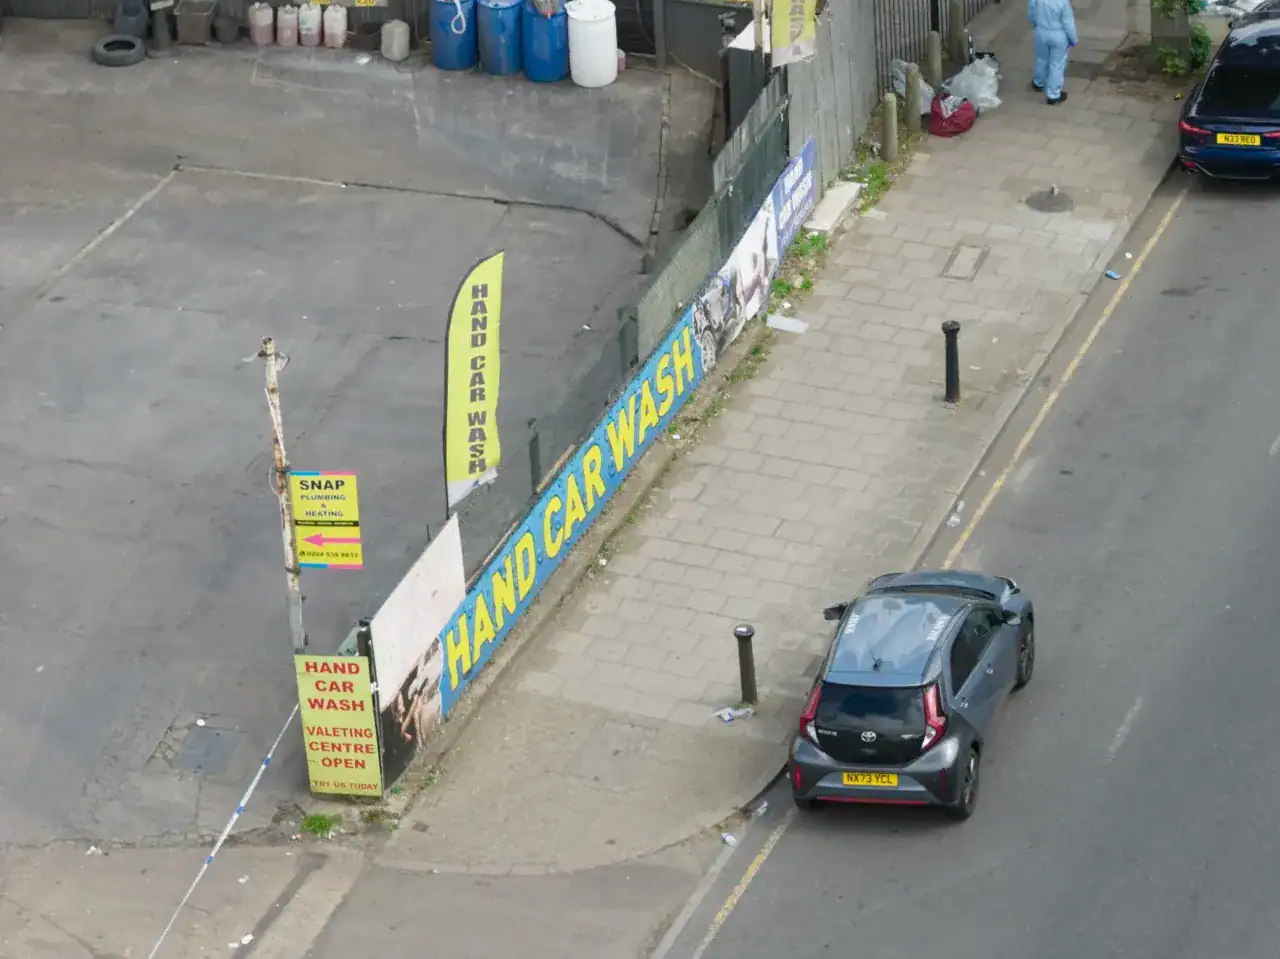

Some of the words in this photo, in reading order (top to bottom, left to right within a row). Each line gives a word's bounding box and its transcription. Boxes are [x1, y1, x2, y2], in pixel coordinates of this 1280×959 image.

[470, 284, 488, 348] HAND
[470, 355, 486, 403] CAR
[467, 410, 488, 474] WASH
[299, 480, 346, 490] SNAP
[445, 531, 536, 691] HAND
[542, 443, 607, 559] CAR
[606, 325, 696, 473] WASH
[304, 660, 360, 675] HAND
[314, 680, 354, 694] CAR
[307, 698, 366, 712] WASH
[306, 726, 374, 739] VALETING
[308, 740, 376, 754] CENTRE
[321, 757, 366, 770] OPEN
[846, 774, 872, 784] NX73
[874, 774, 893, 784] YCL
[348, 782, 380, 791] TODAY
